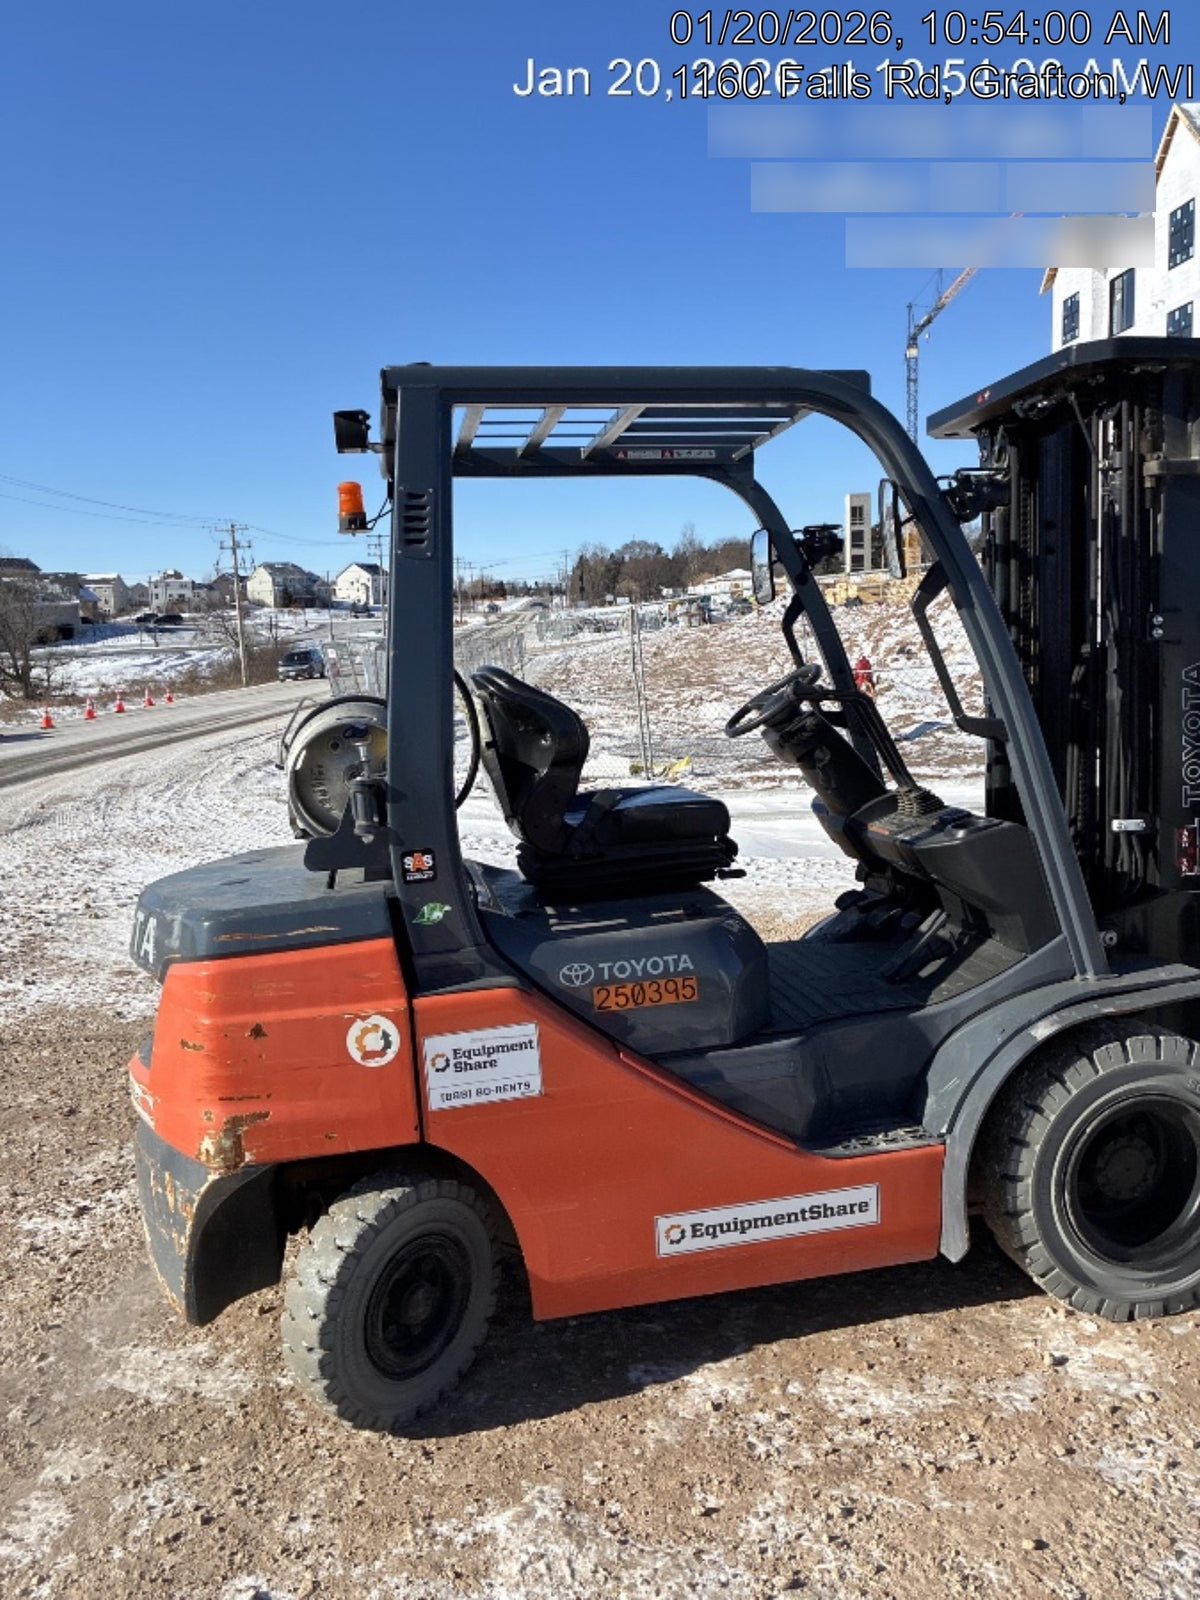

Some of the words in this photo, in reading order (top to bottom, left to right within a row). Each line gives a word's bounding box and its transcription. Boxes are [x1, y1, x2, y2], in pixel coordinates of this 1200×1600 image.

[598, 954, 695, 980] TOYOTA
[596, 977, 697, 1011] 250395
[452, 1038, 535, 1060] Equipment
[453, 1058, 498, 1073] Share
[690, 1200, 871, 1239] EquipmentShare
